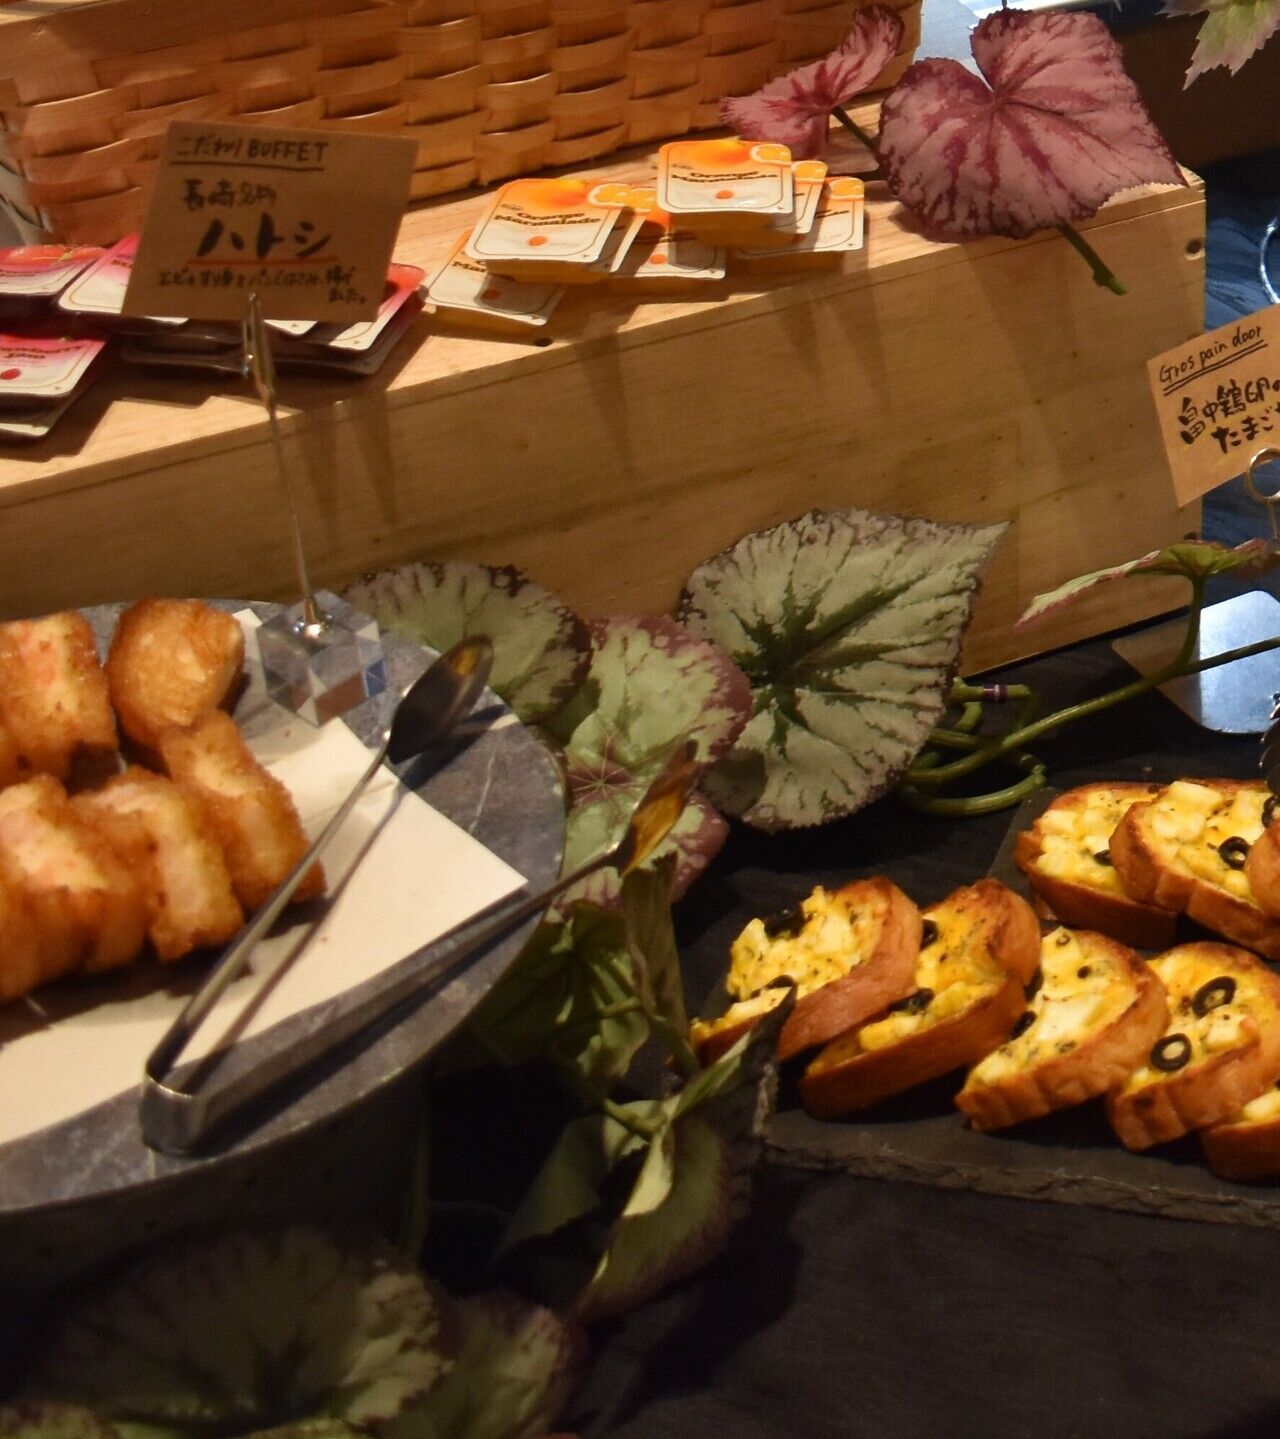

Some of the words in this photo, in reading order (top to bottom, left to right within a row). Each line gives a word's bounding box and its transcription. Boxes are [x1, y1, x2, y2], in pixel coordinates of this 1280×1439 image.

[247, 139, 330, 162] BUFFET
[196, 212, 333, 258] ハトシ
[1159, 358, 1195, 383] Gros
[1199, 341, 1228, 368] pain
[1232, 325, 1264, 347] door
